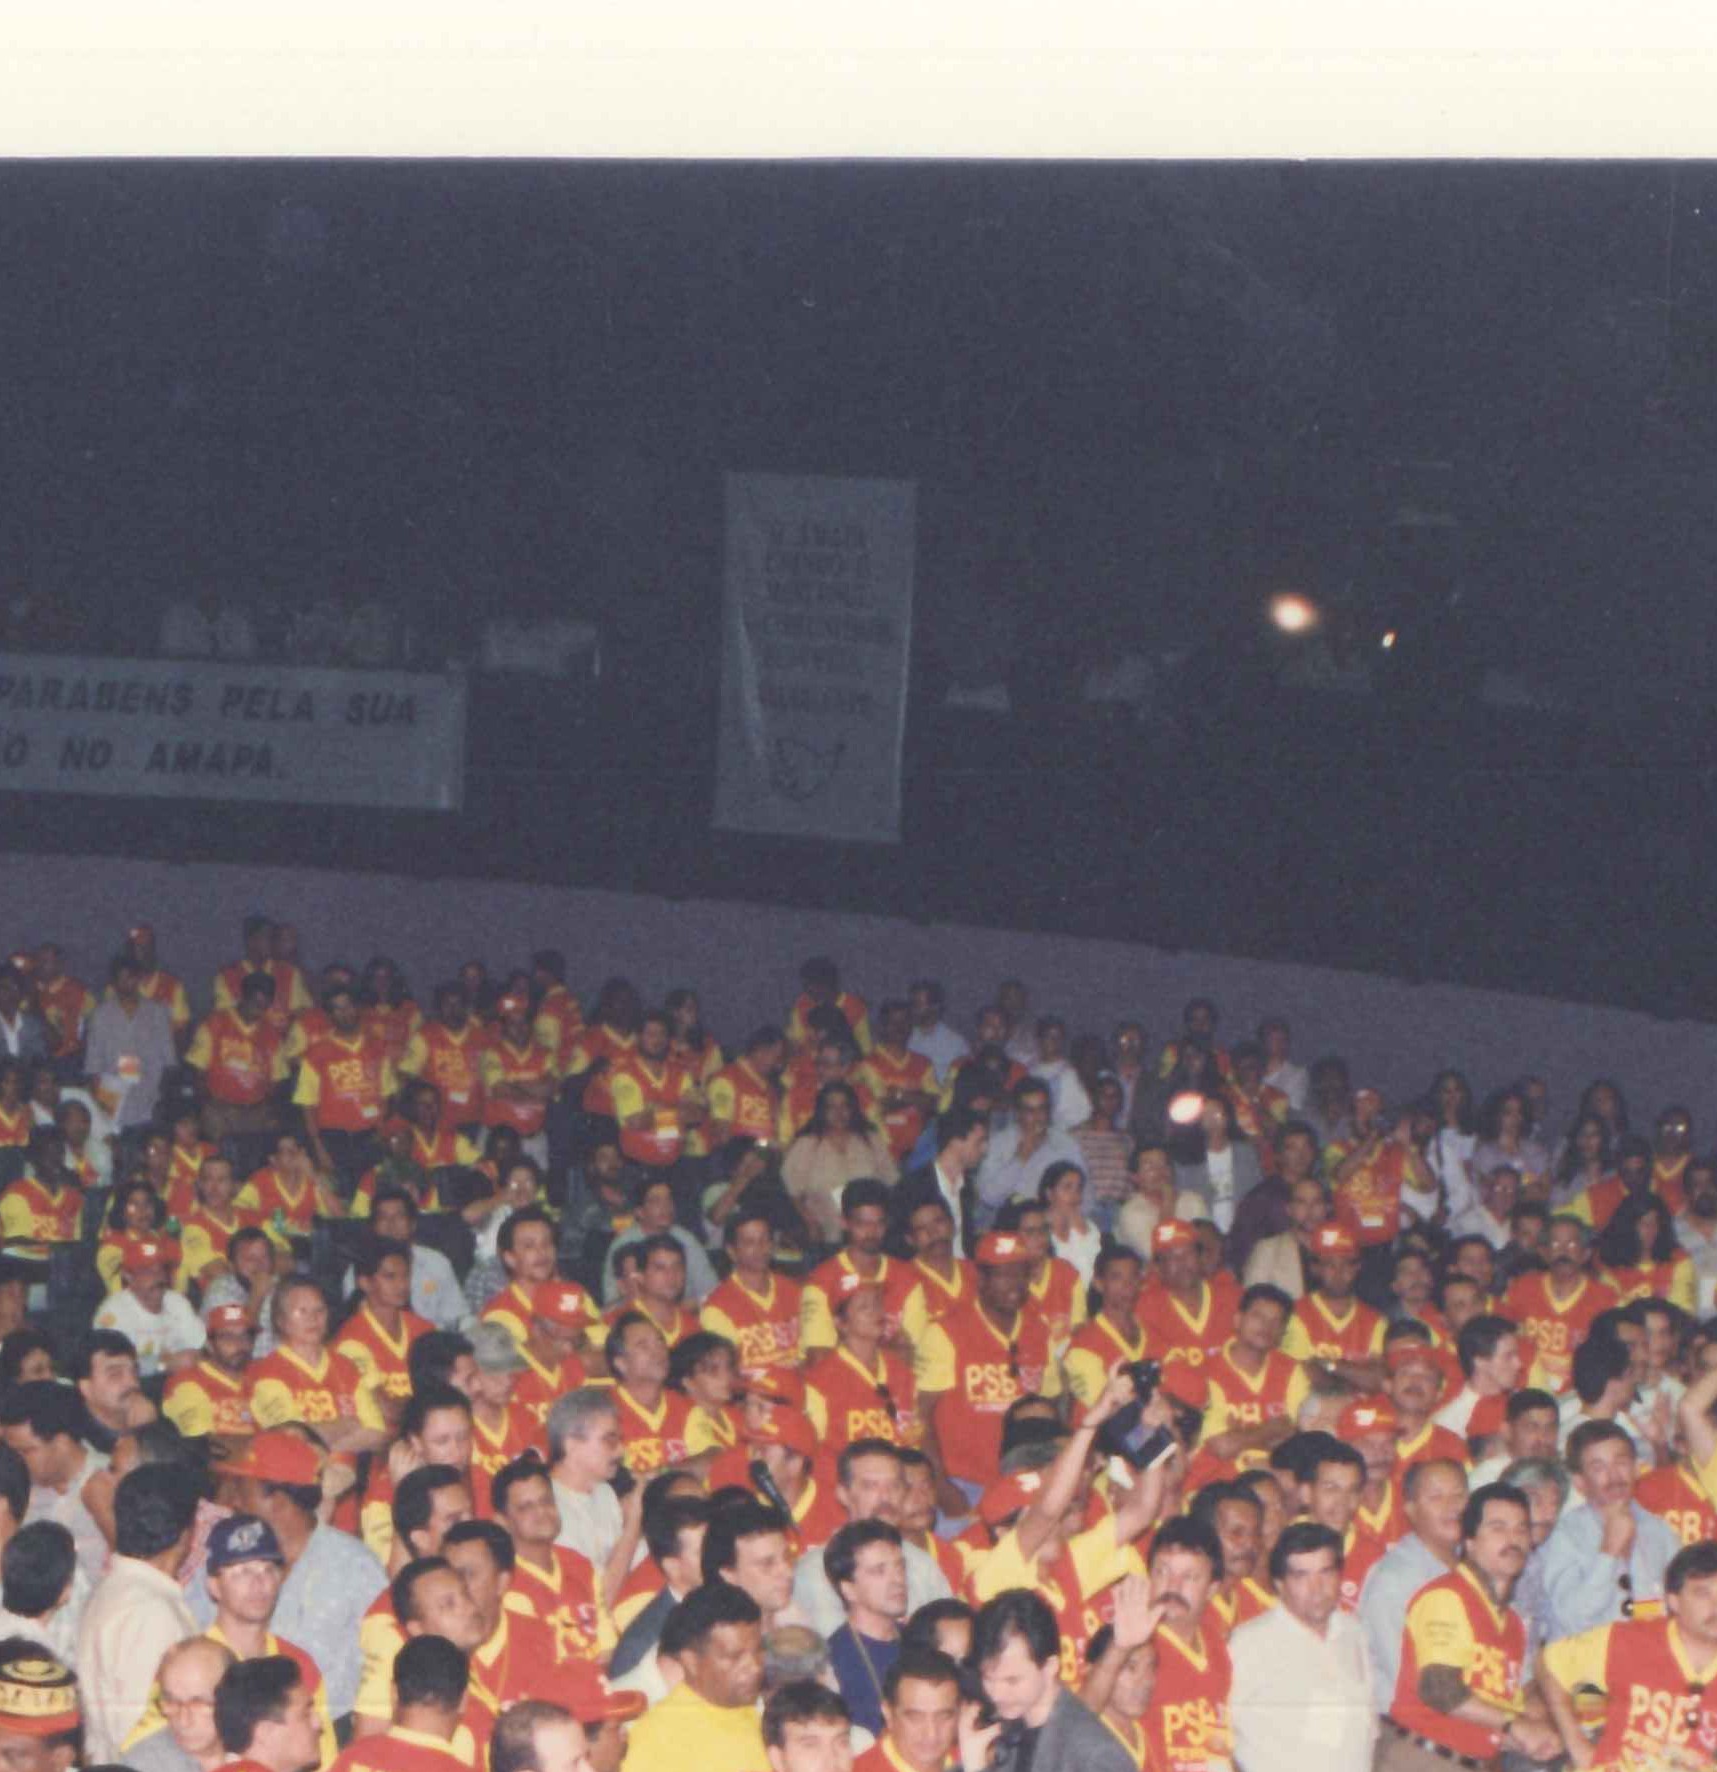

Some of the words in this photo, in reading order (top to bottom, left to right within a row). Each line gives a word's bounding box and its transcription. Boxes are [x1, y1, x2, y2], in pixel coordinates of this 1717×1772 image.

[219, 683, 314, 722] PELA
[346, 691, 416, 727] SUA
[58, 736, 112, 771] NO
[1525, 1317, 1568, 1352] PSB
[1664, 1511, 1700, 1546] SB
